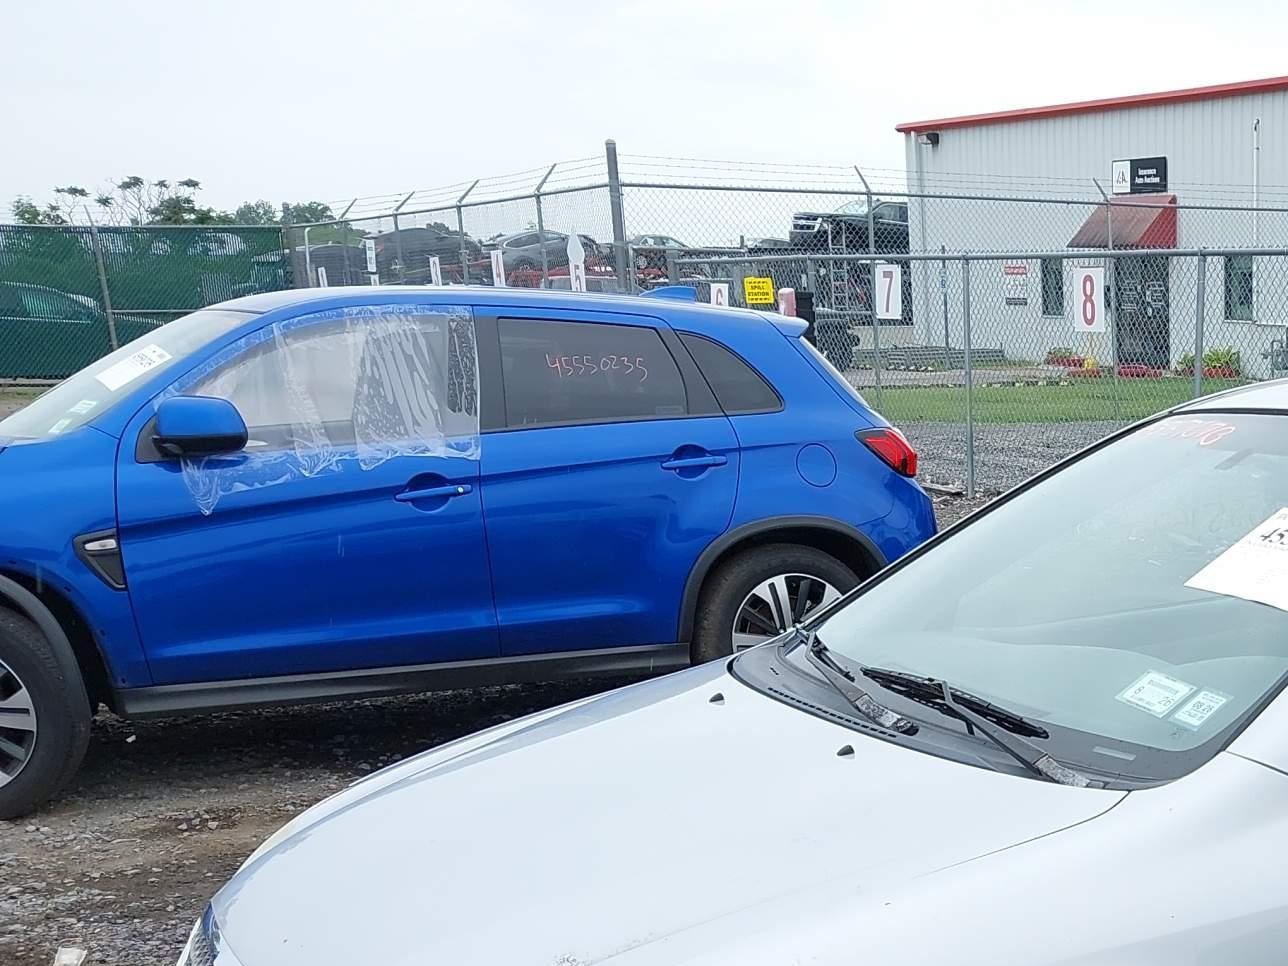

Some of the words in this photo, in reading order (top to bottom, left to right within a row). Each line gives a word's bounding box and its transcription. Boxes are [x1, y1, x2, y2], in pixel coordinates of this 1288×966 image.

[882, 270, 894, 313] 7
[1082, 274, 1096, 326] 8
[545, 353, 648, 382] 45550235
